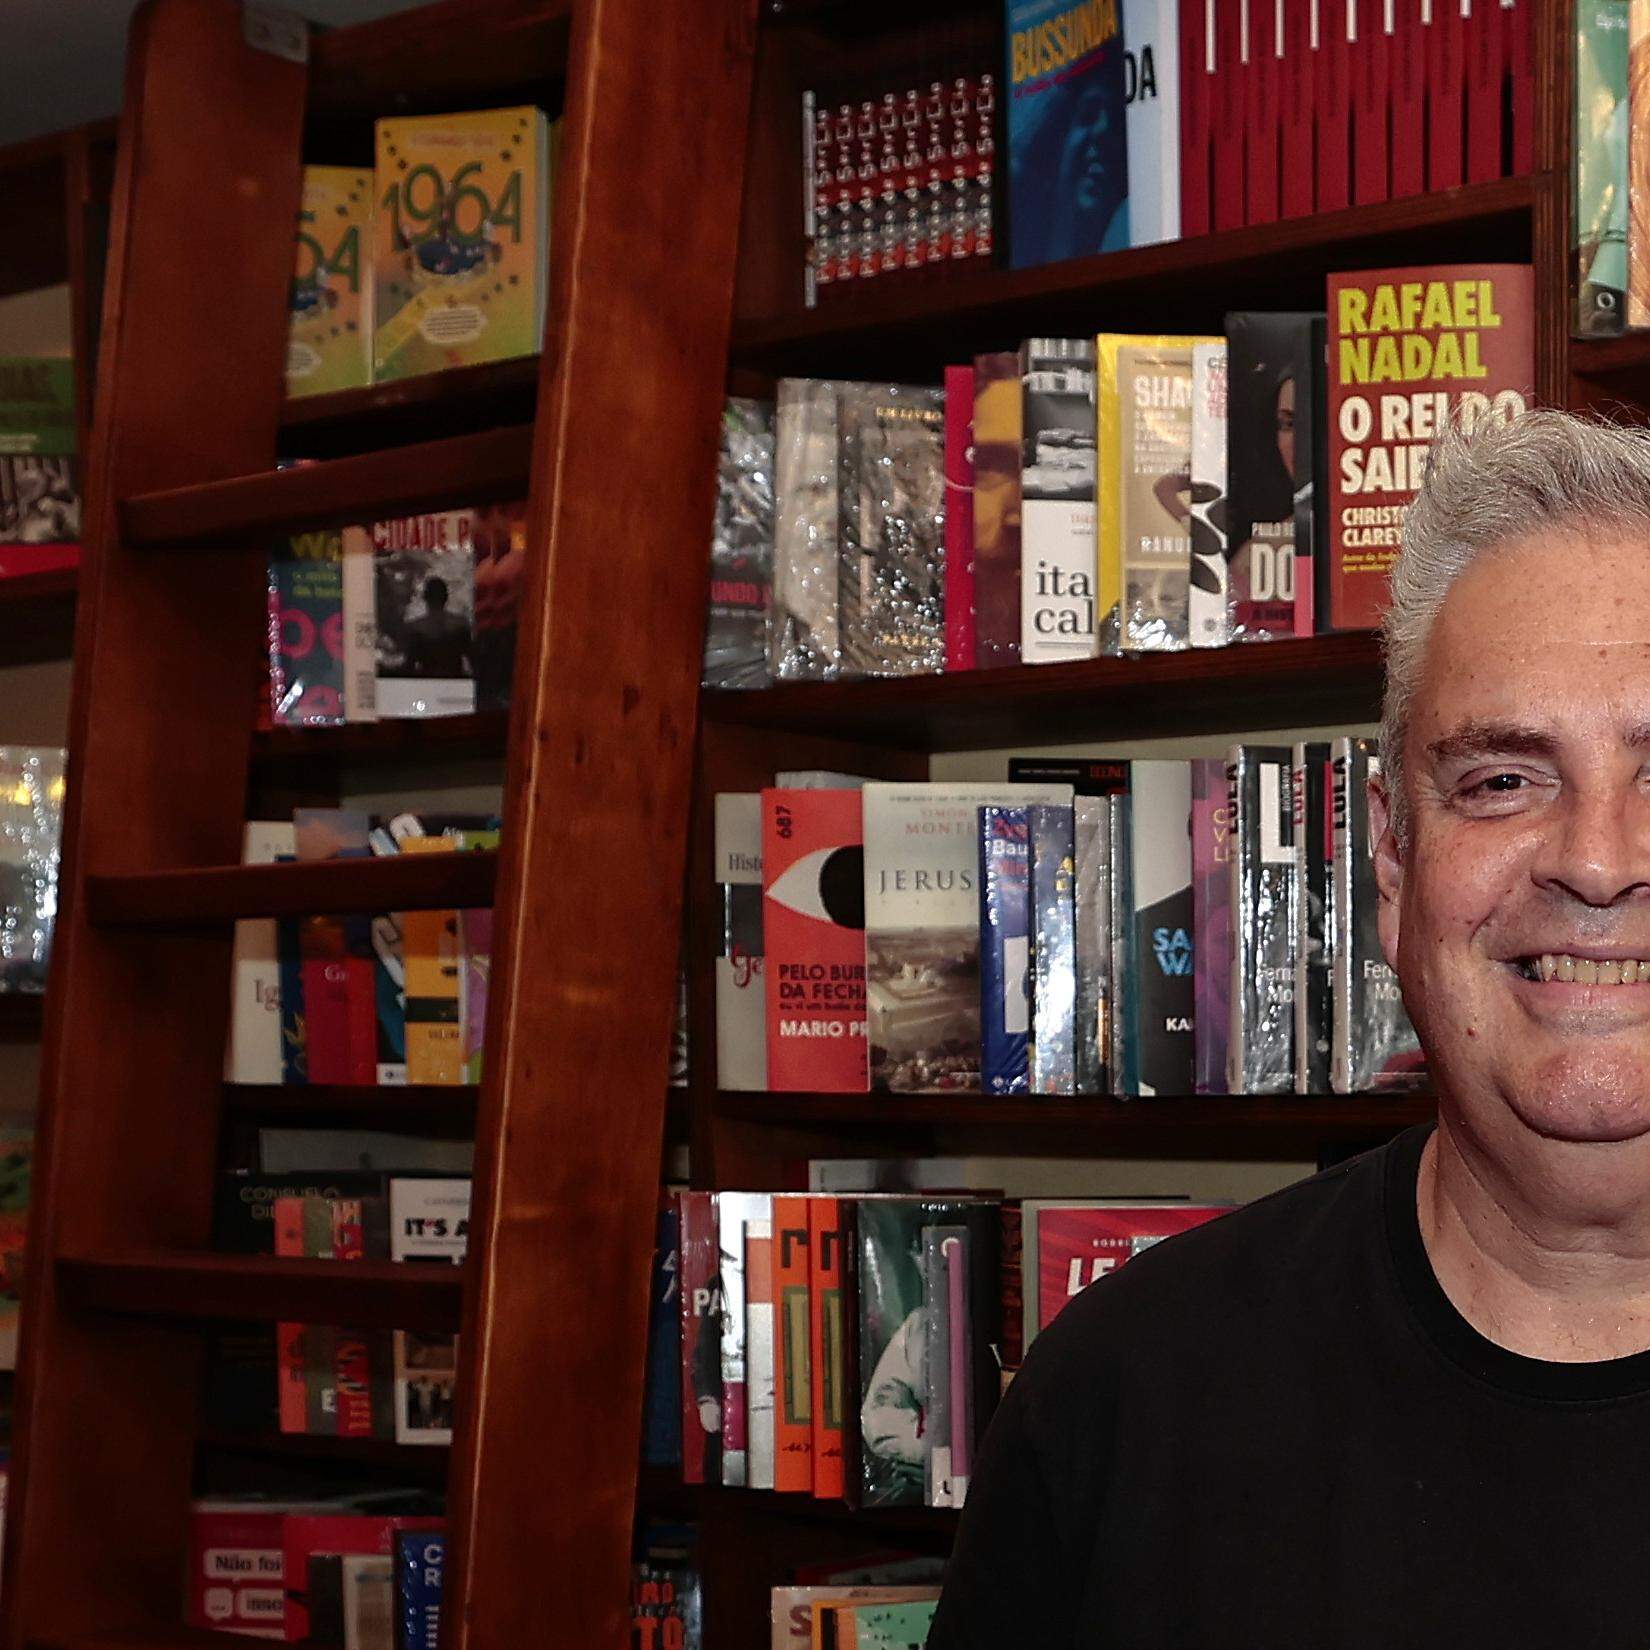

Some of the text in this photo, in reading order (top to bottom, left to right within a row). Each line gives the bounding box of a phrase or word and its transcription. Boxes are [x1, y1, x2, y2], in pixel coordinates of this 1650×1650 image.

[381, 161, 523, 252] 1964
[1337, 280, 1502, 335] RAFAEL
[1339, 332, 1488, 385] NADAL
[1339, 394, 1449, 443] O REI
[1334, 757, 1346, 829] LULA
[776, 805, 792, 838] 687
[879, 871, 973, 891] JERUS
[778, 964, 825, 980] PELO
[780, 983, 806, 999] DA
[780, 1020, 844, 1036] MARIO
